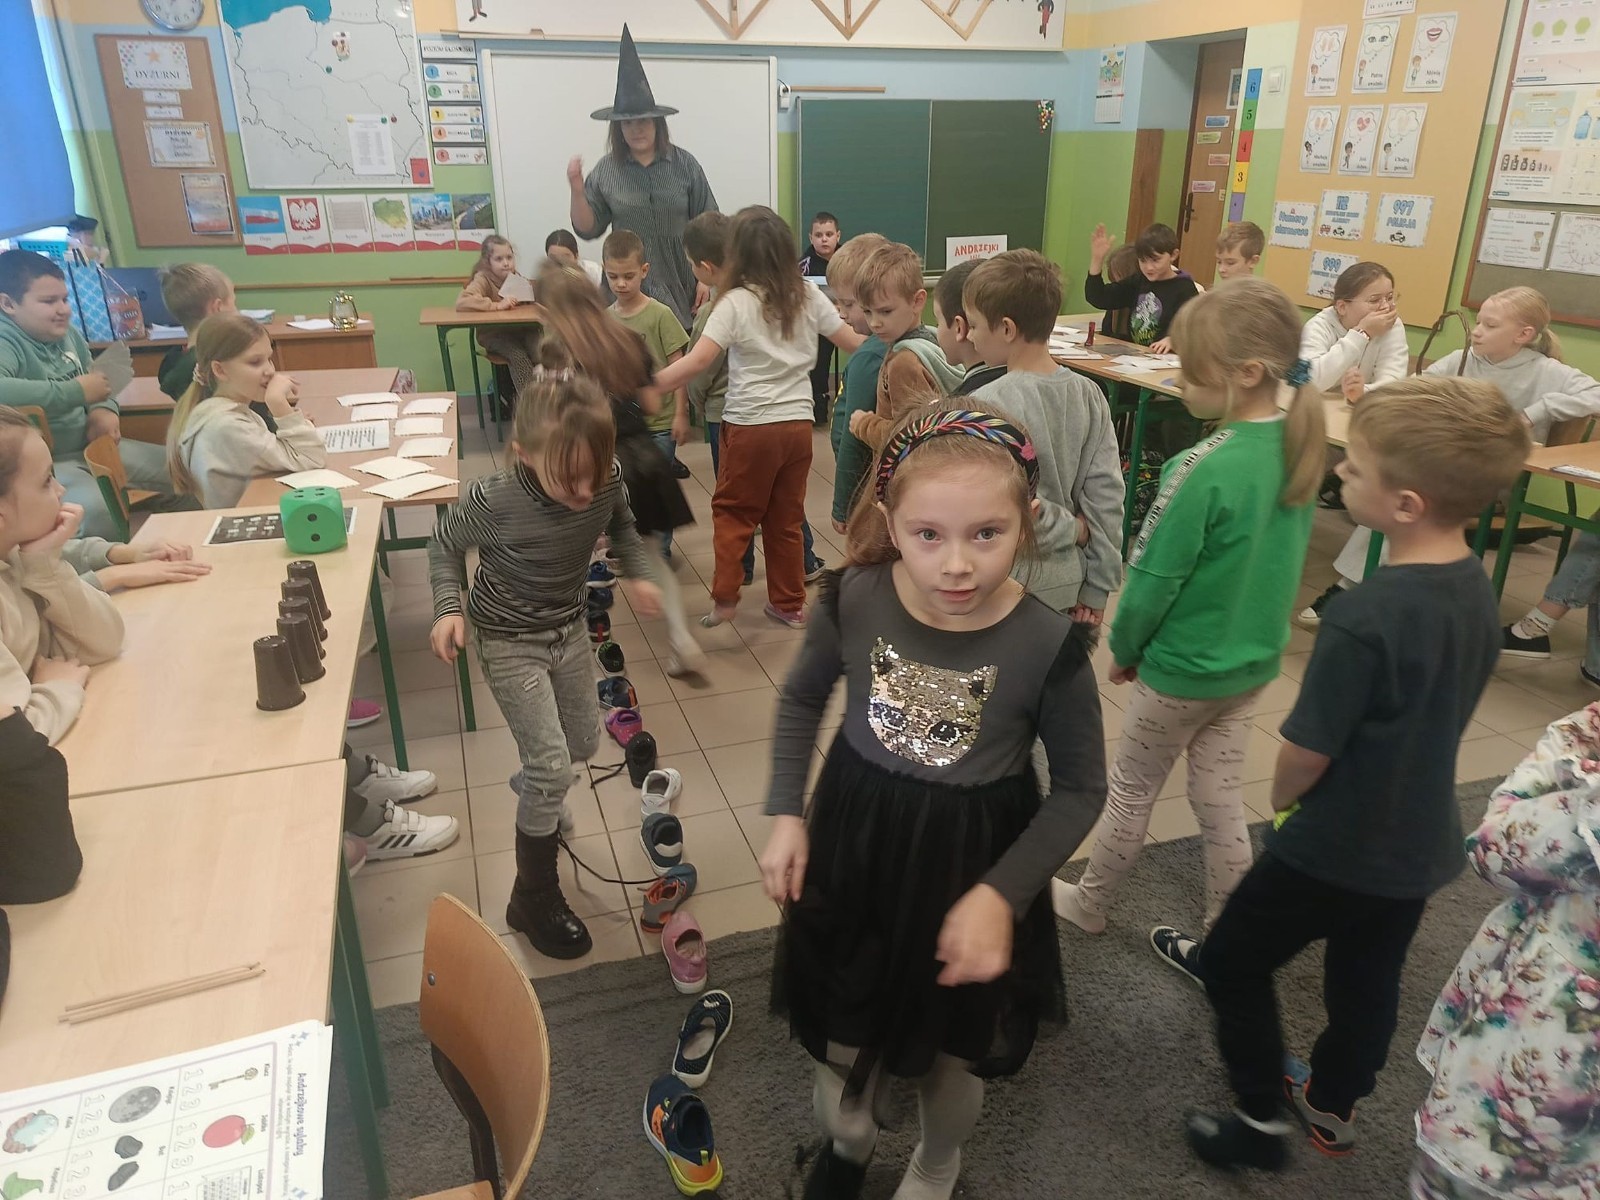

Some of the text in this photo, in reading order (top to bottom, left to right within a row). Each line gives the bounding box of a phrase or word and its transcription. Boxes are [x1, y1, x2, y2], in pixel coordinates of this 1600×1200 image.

[1250, 82, 1256, 93] 6
[1246, 109, 1252, 120] 5
[1241, 143, 1247, 153] 4
[1237, 171, 1243, 183] 3
[1393, 199, 1415, 216] 997
[955, 244, 999, 256] ANDRZEJKI
[1323, 257, 1341, 272] 999
